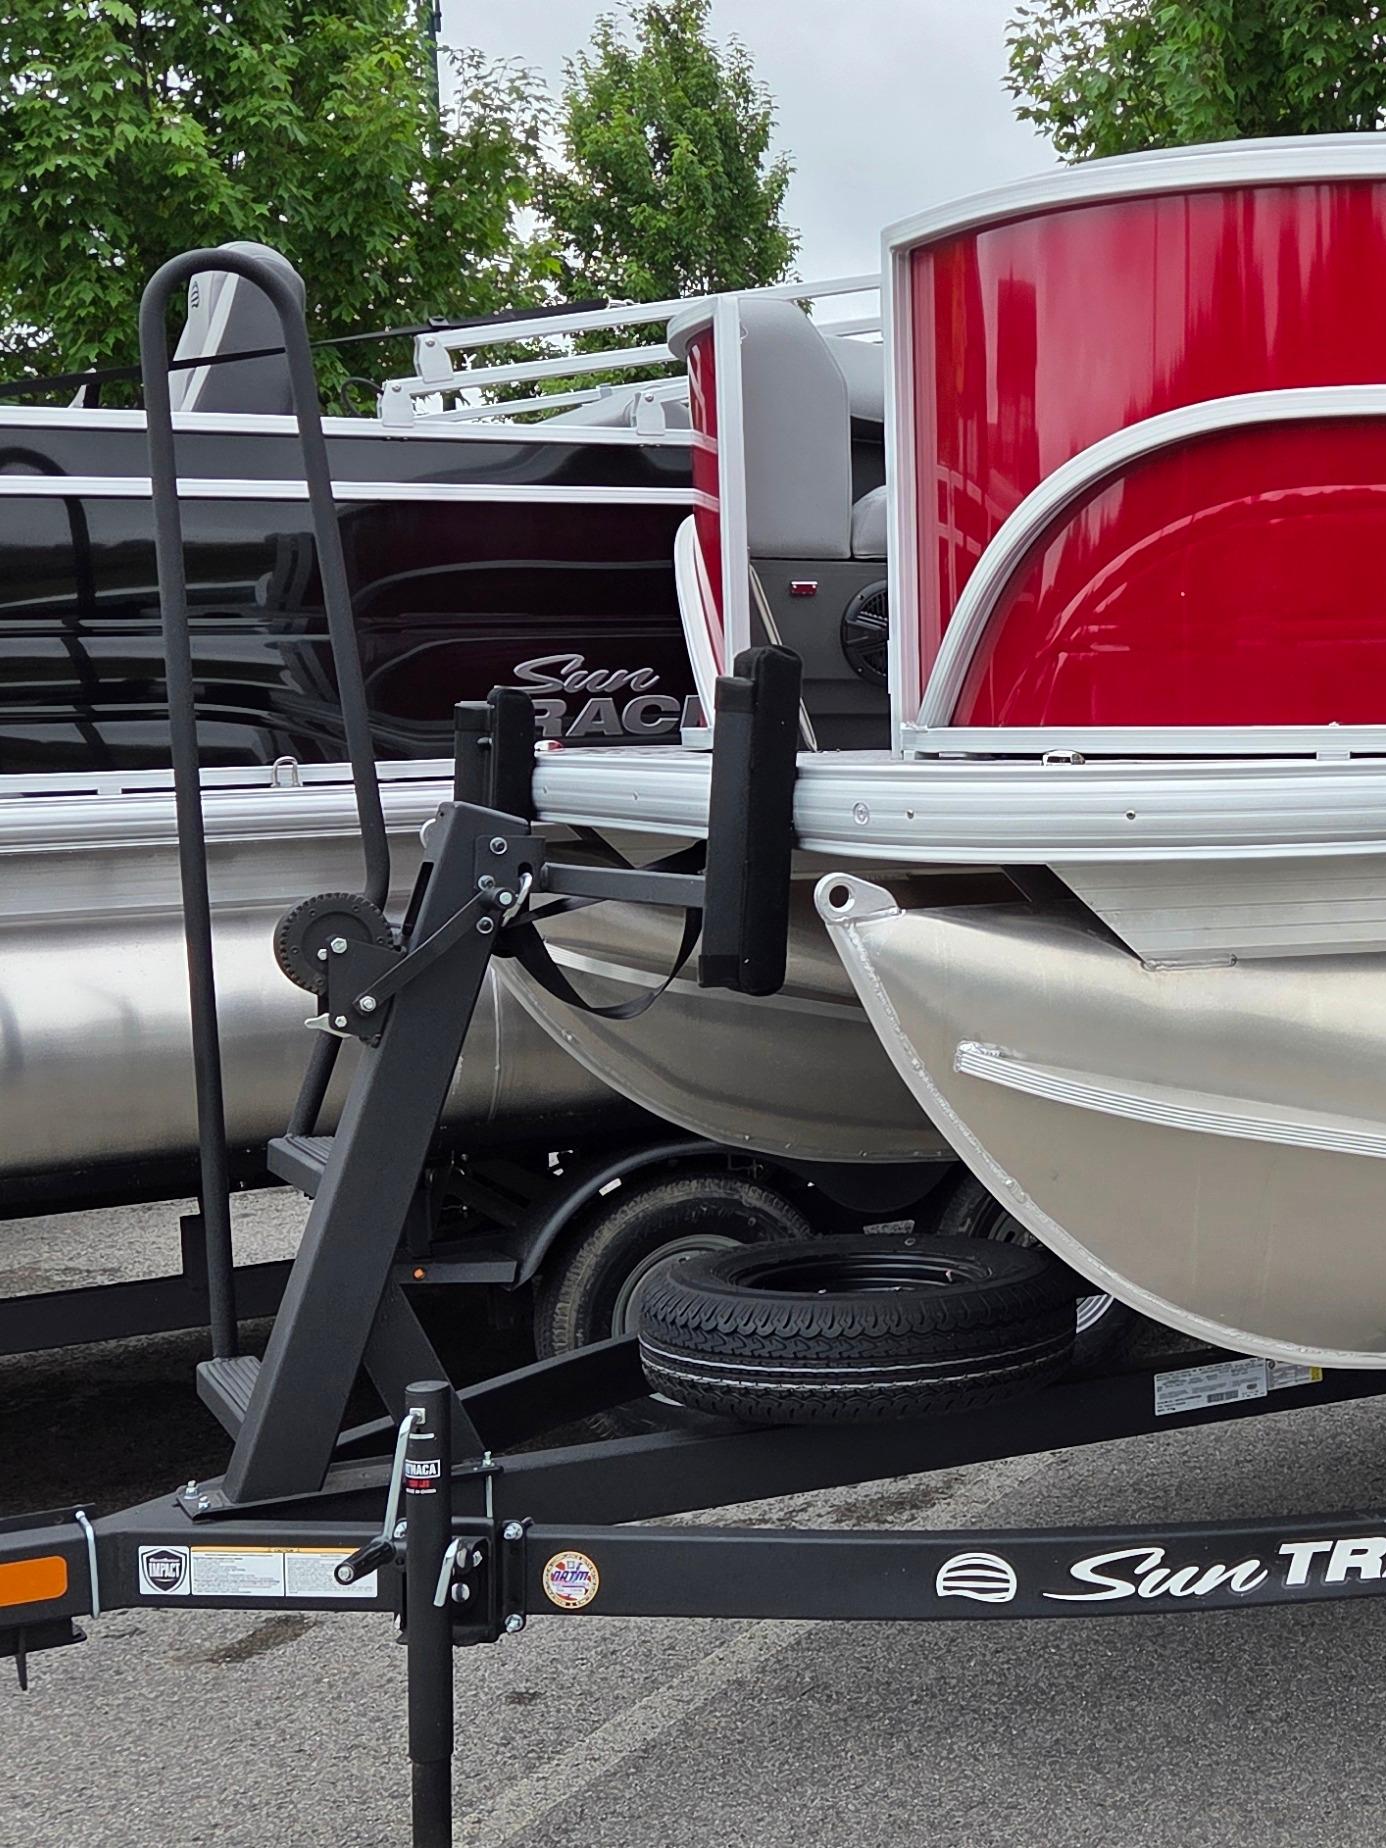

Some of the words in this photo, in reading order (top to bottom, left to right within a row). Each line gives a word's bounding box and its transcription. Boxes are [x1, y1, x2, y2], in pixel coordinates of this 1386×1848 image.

[494, 653, 661, 695] Sun
[148, 1562, 181, 1578] IMPACT
[1042, 1547, 1269, 1601] Sun
